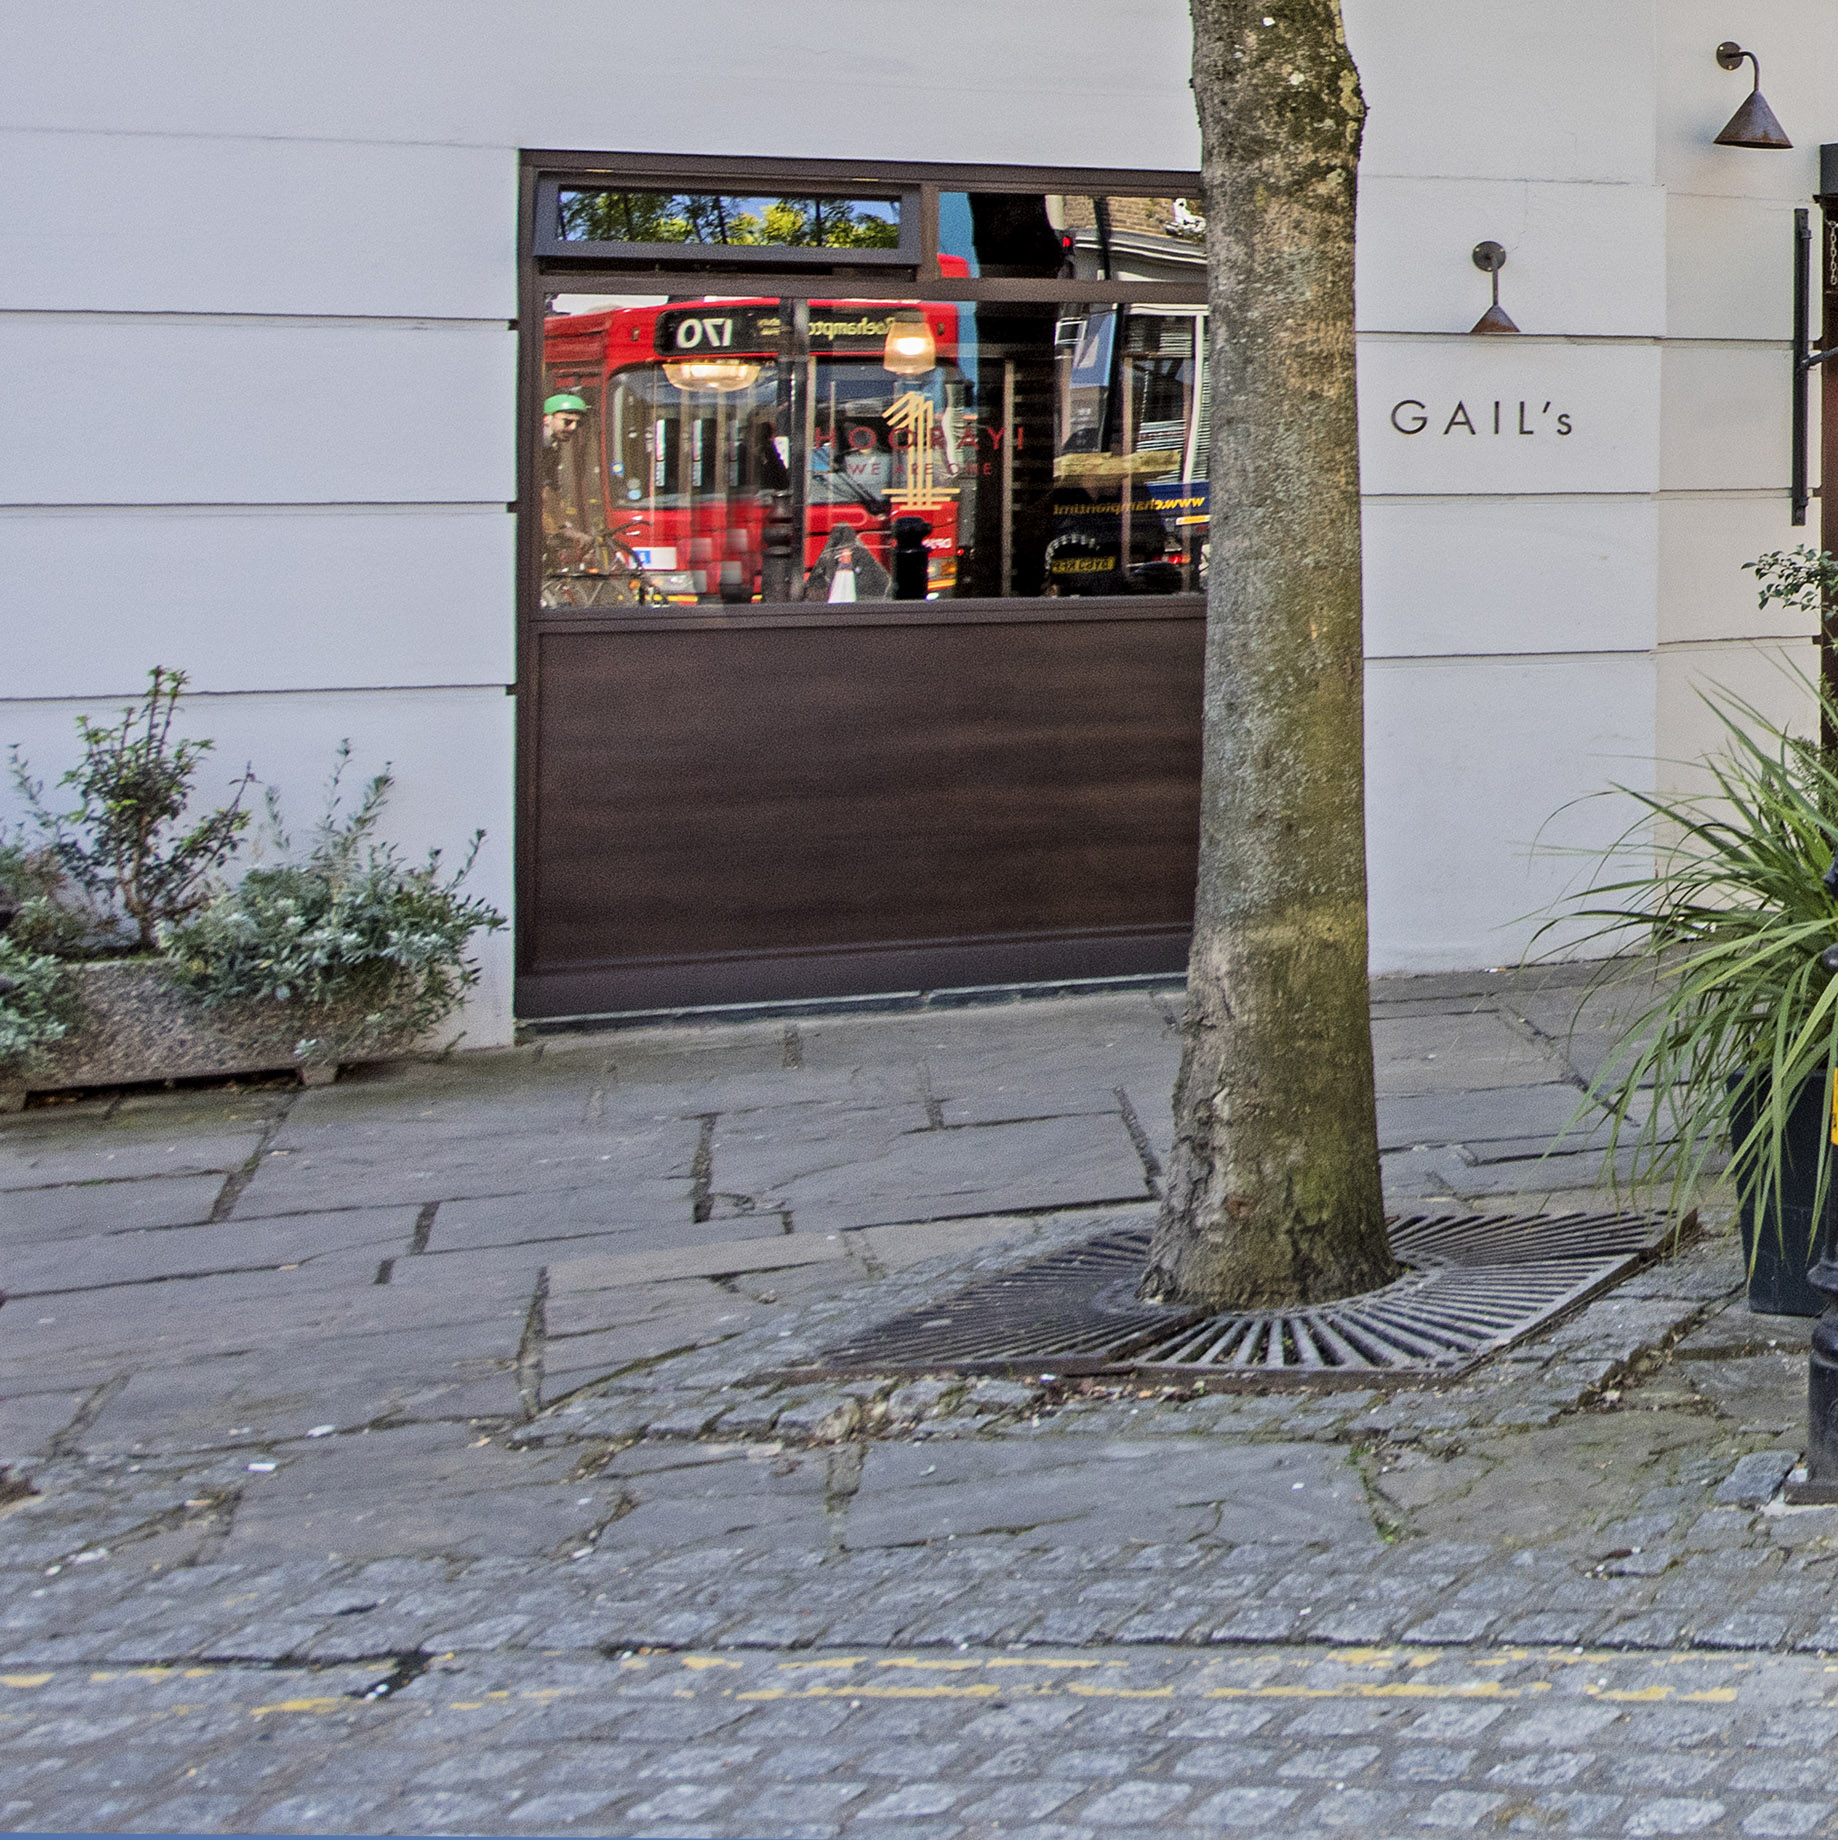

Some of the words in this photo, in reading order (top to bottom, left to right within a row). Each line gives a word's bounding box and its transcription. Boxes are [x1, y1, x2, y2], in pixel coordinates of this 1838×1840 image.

[1390, 398, 1573, 436] GAIL's
[814, 426, 1024, 450] HOORAY!
[850, 463, 881, 476] WE
[949, 462, 992, 476] ONE
